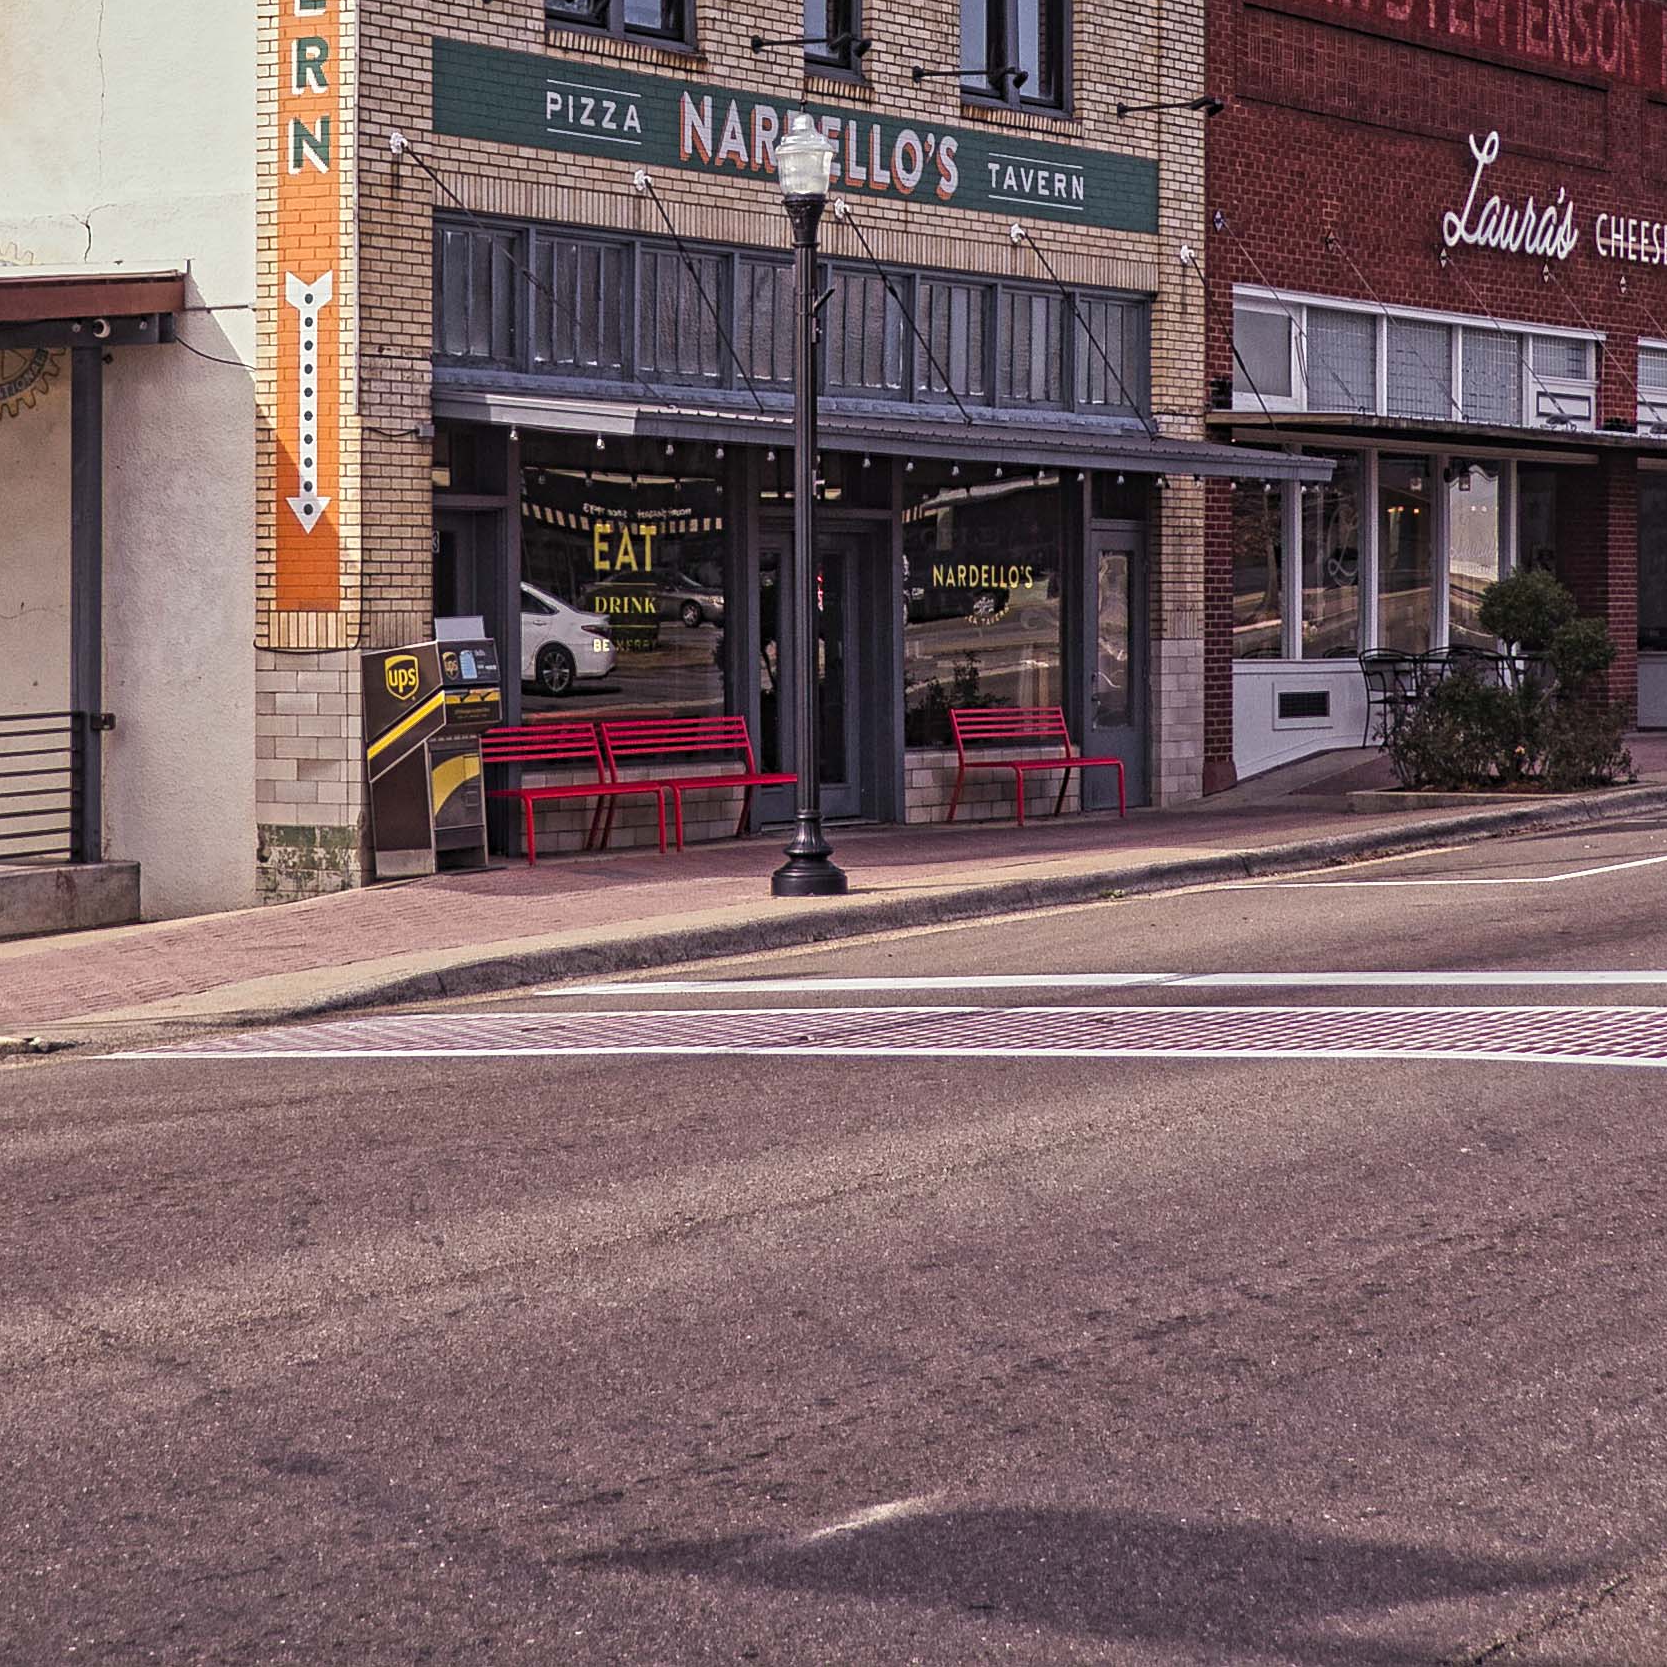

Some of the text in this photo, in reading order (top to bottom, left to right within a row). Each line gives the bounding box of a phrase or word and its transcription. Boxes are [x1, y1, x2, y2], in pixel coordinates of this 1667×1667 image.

[545, 89, 643, 135] PIZZA
[679, 90, 960, 201] NARELLO'S
[988, 160, 1087, 203] TAVERN
[1442, 130, 1580, 260] Laura's
[594, 523, 658, 572] EAT
[933, 564, 1034, 589] NARDELLO'S
[594, 596, 657, 614] DRINK
[593, 638, 611, 653] BE
[388, 669, 417, 693] ups
